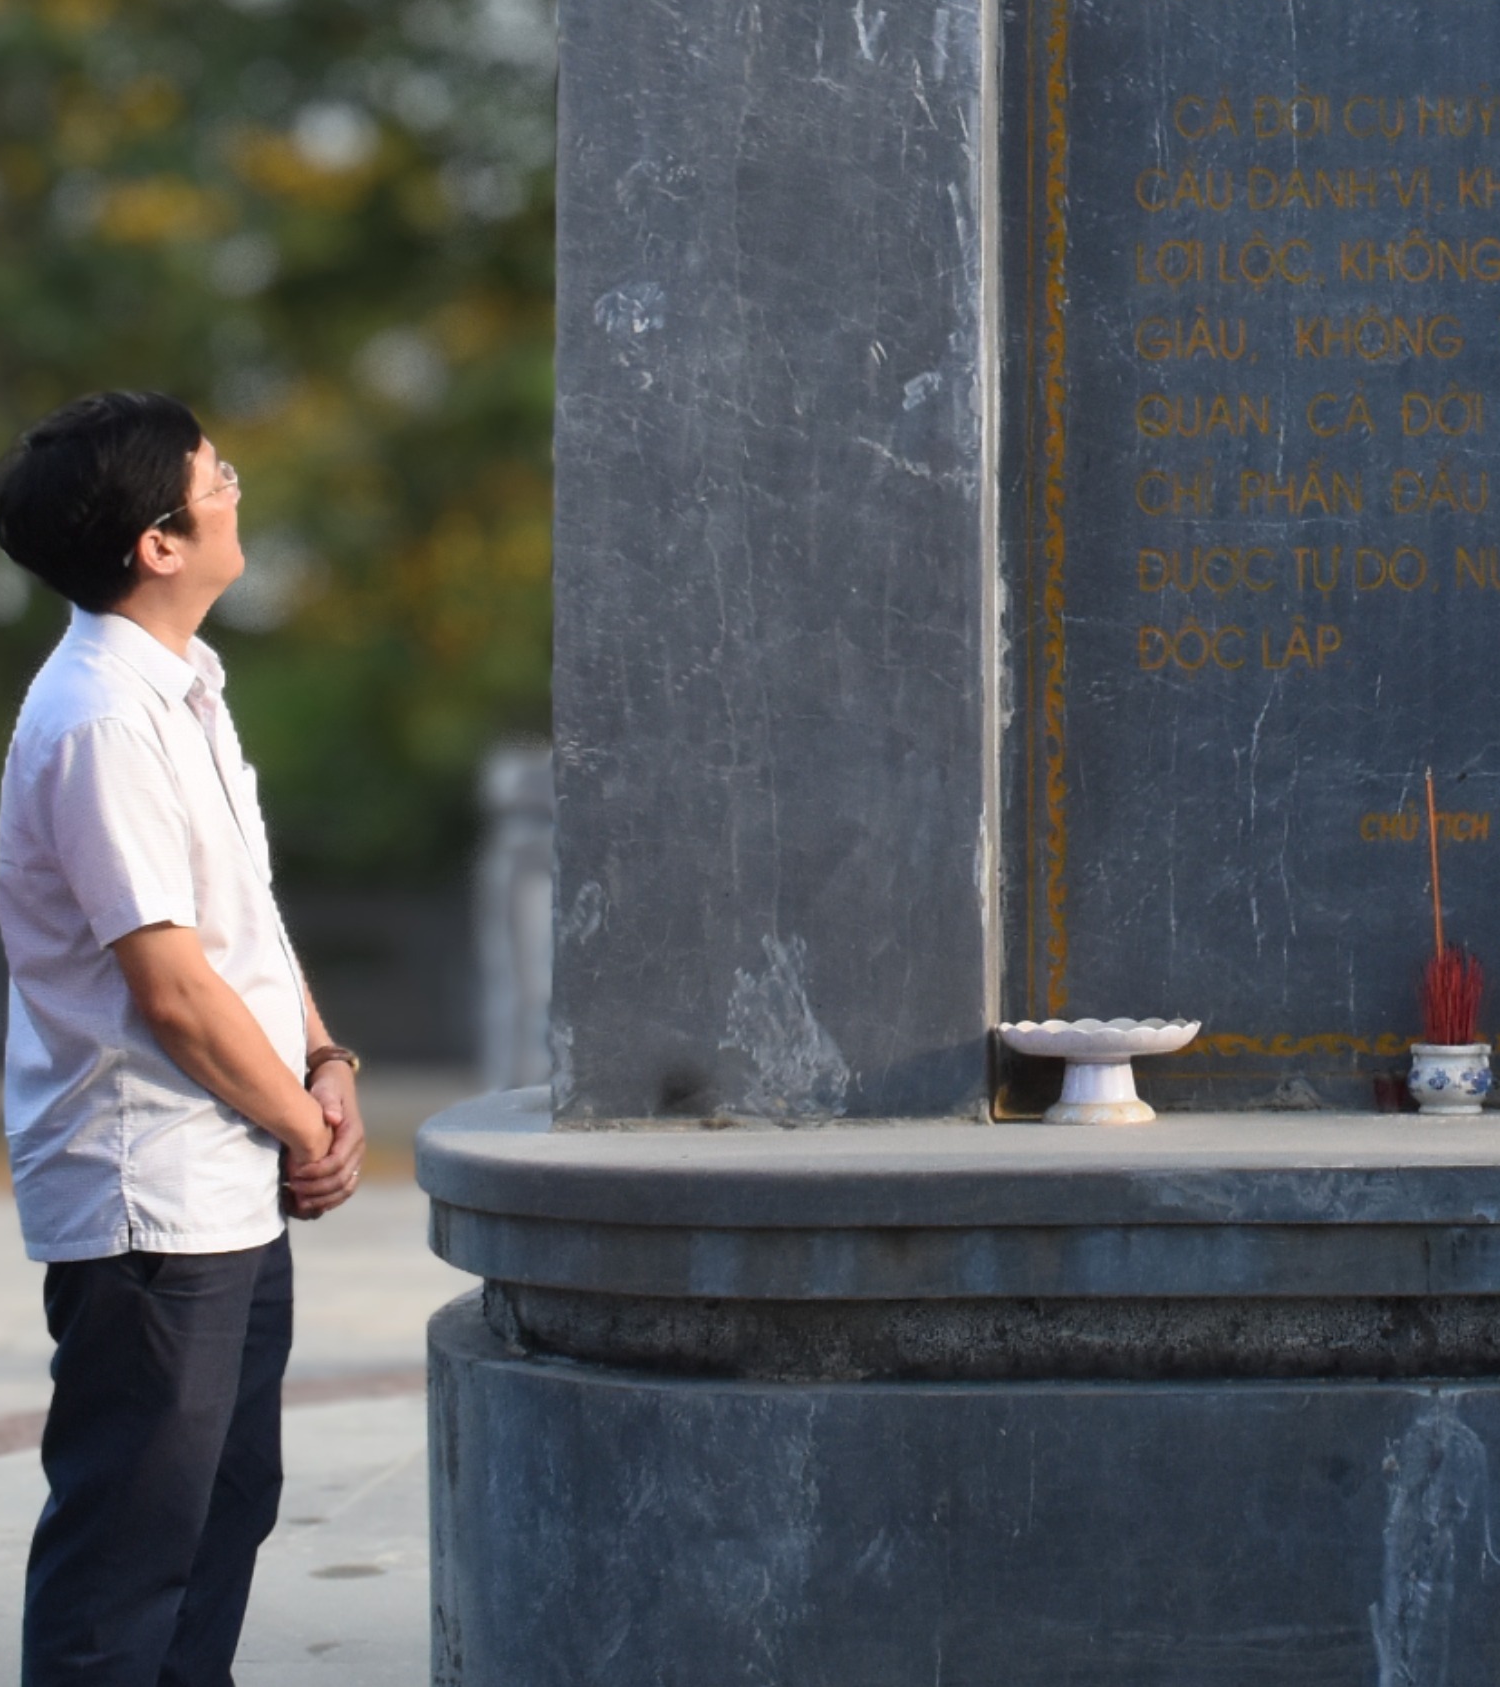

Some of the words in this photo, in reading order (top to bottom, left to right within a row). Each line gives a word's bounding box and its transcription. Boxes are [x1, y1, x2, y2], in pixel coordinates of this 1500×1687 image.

[1173, 85, 1240, 140] CẢ
[1253, 83, 1331, 140] ĐỜI
[1343, 94, 1405, 146] CỤ
[1247, 165, 1377, 210] DANH
[1135, 239, 1204, 291] LỢI
[1295, 305, 1466, 361] KHÔNG
[1306, 378, 1377, 438] CẢ
[1400, 381, 1484, 438] ĐỜI
[1239, 455, 1364, 515] PHẤN
[1136, 546, 1275, 600] ĐƯỢC
[1292, 544, 1343, 601] TỰ
[1136, 616, 1246, 680] ĐỘC
